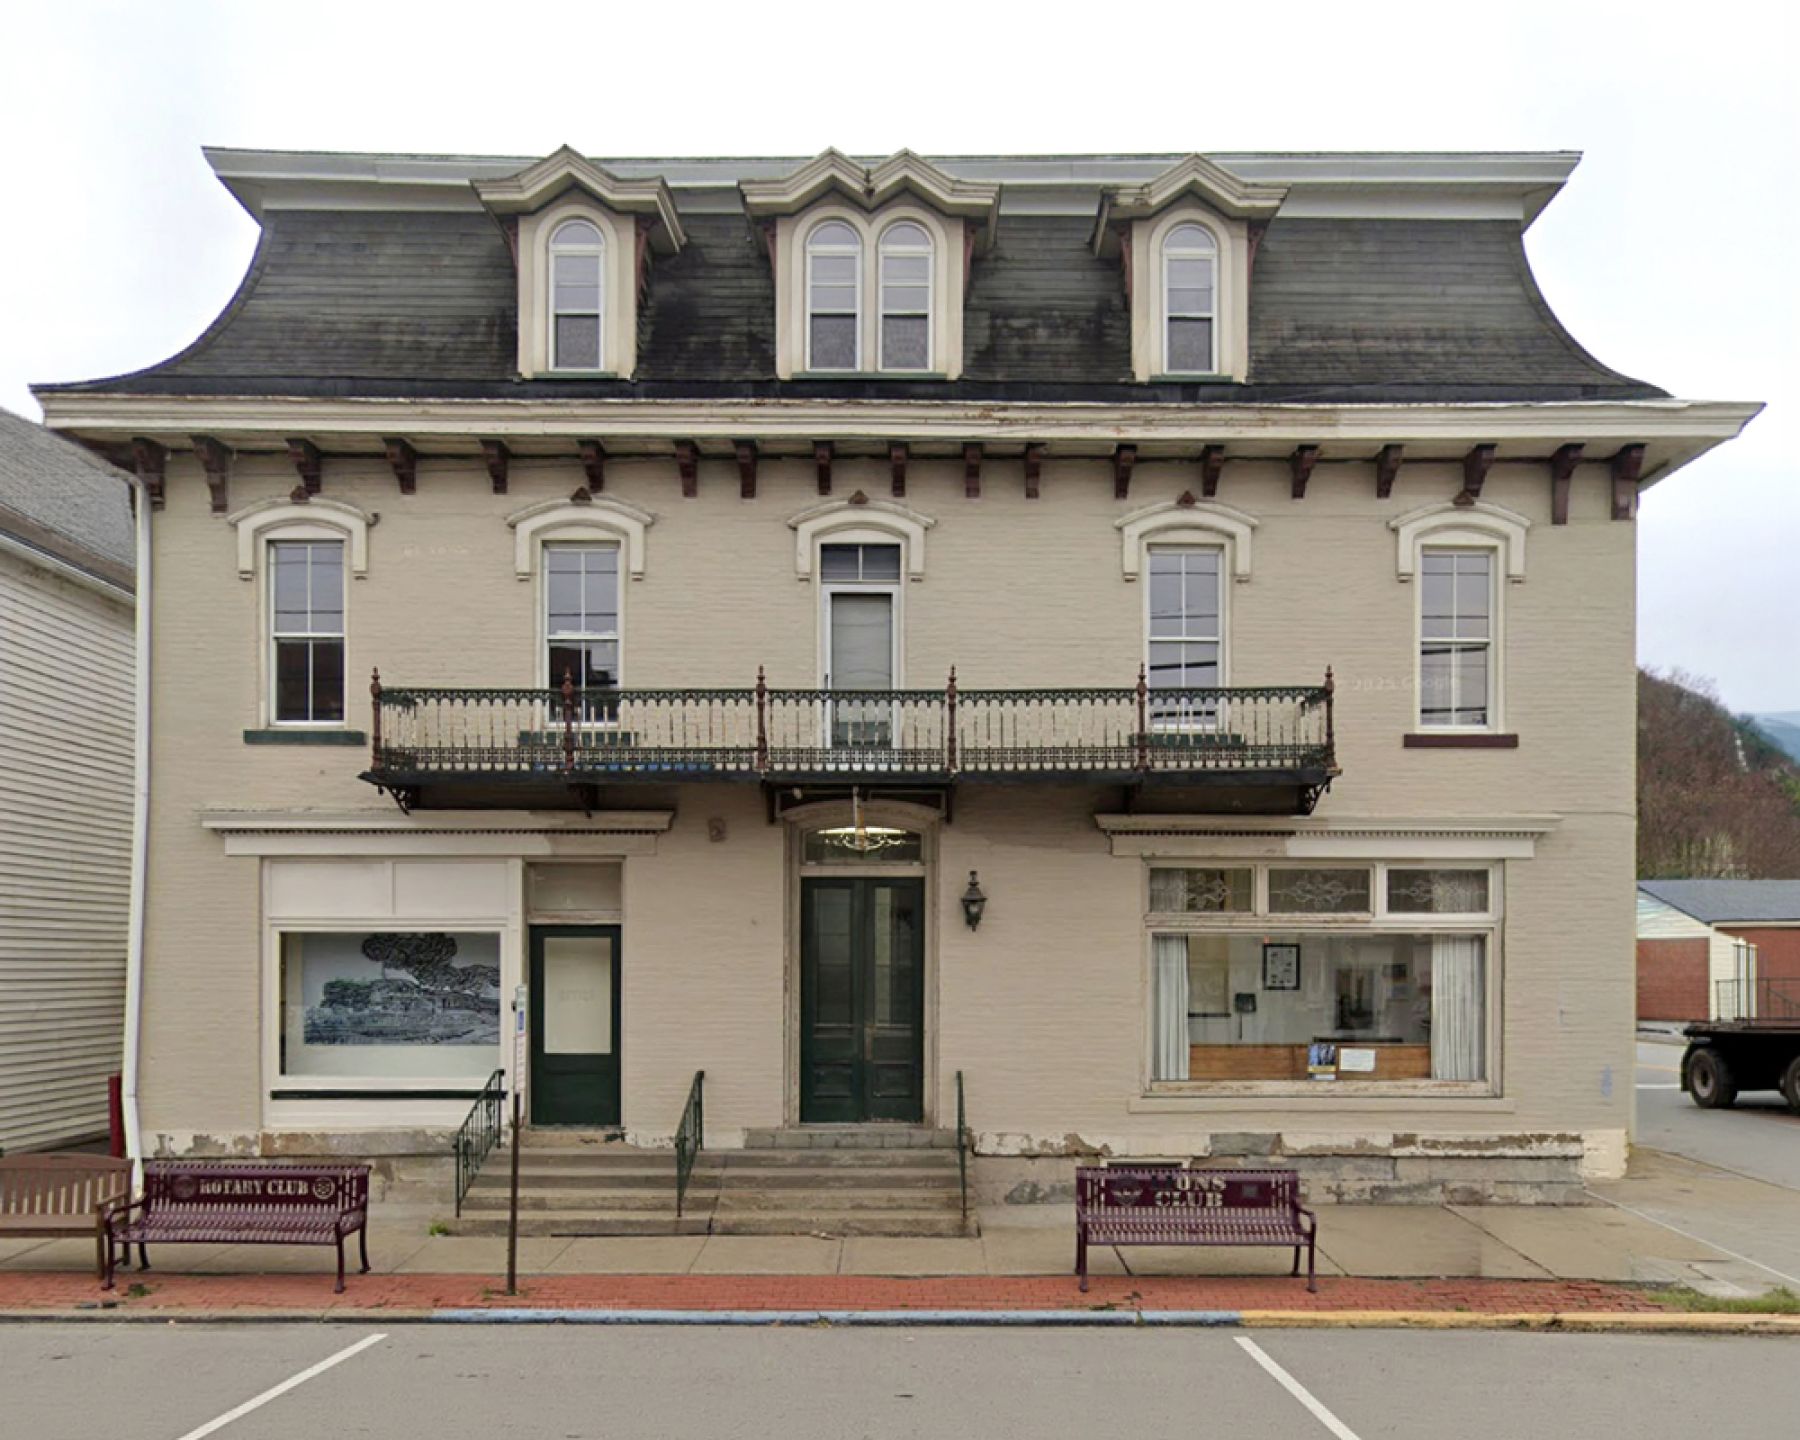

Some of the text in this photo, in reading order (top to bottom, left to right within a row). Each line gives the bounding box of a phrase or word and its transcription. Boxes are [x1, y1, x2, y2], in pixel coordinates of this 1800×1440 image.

[199, 1178, 308, 1195] ROTARY CLUB
[1154, 1191, 1223, 1207] CLUB
